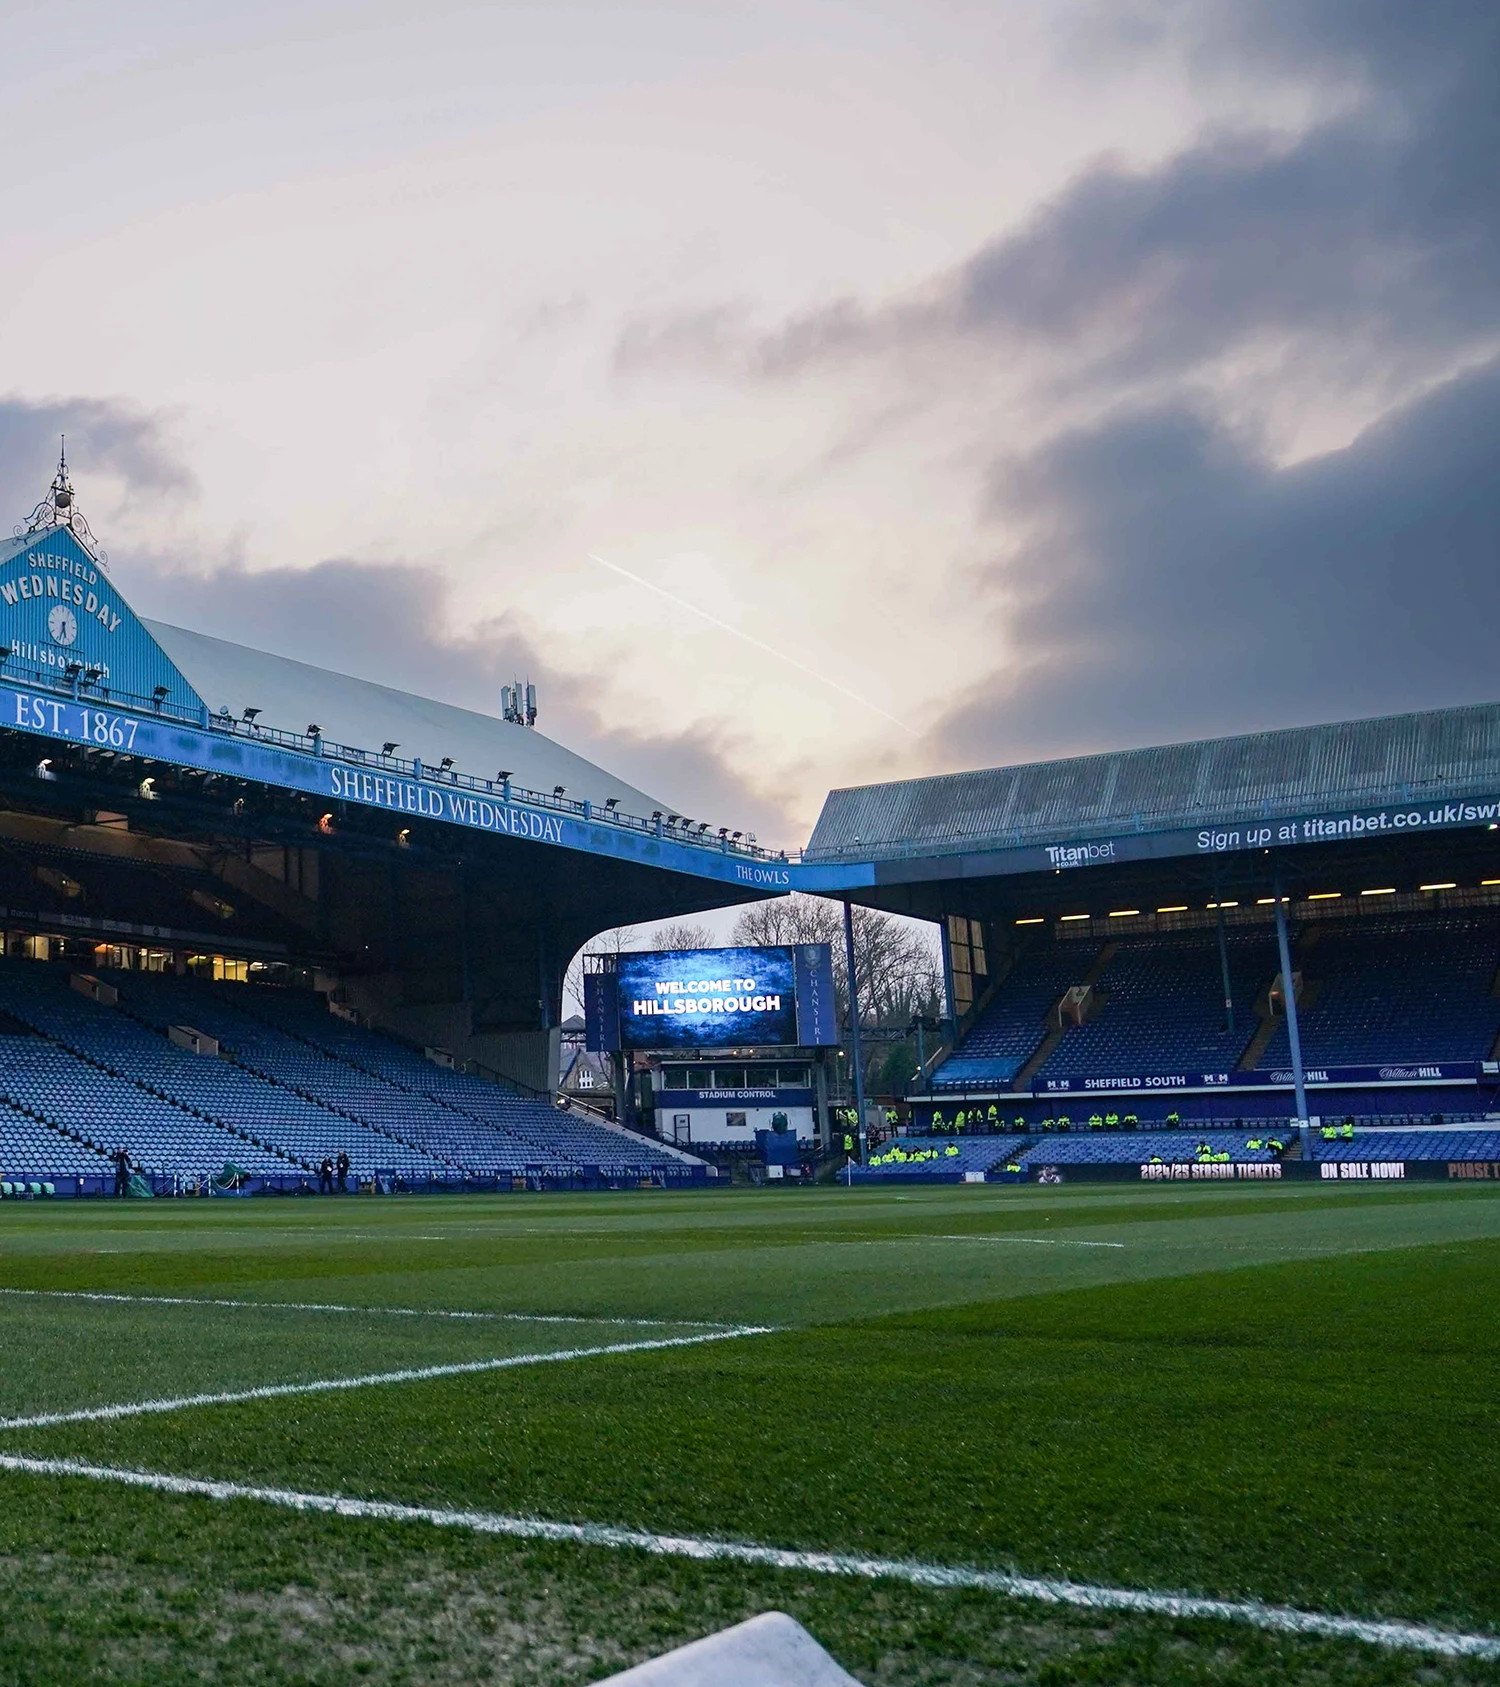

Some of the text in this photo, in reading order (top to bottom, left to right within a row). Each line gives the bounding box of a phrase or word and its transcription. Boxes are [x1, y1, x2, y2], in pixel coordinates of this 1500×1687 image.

[28, 552, 97, 585] SHEFFIELD
[0, 575, 122, 632] WEDNESDAY
[14, 692, 138, 749] EST. 1867
[330, 767, 564, 844] SHEFFIELD WEDNESDAY
[1197, 830, 1240, 850] Sign
[1246, 828, 1271, 845] up
[1278, 823, 1297, 839] at
[1045, 841, 1115, 863] Titanbet
[736, 865, 789, 884] THE OWLS
[655, 978, 756, 994] WELCOME TO
[633, 995, 781, 1015] HILLSBOROUGH
[809, 969, 821, 1045] CHANSIRI
[1084, 1076, 1186, 1089] SHEFFIELD SOUTH
[1269, 1071, 1329, 1083] Willi HILL
[1379, 1067, 1442, 1080] William HILL
[1047, 1080, 1070, 1088] MM
[699, 1090, 776, 1099] STADIUM CONTROL
[1140, 1163, 1282, 1180] 2024/25 SEASON TICKETS
[1320, 1162, 1405, 1179] ON SALE NOW!
